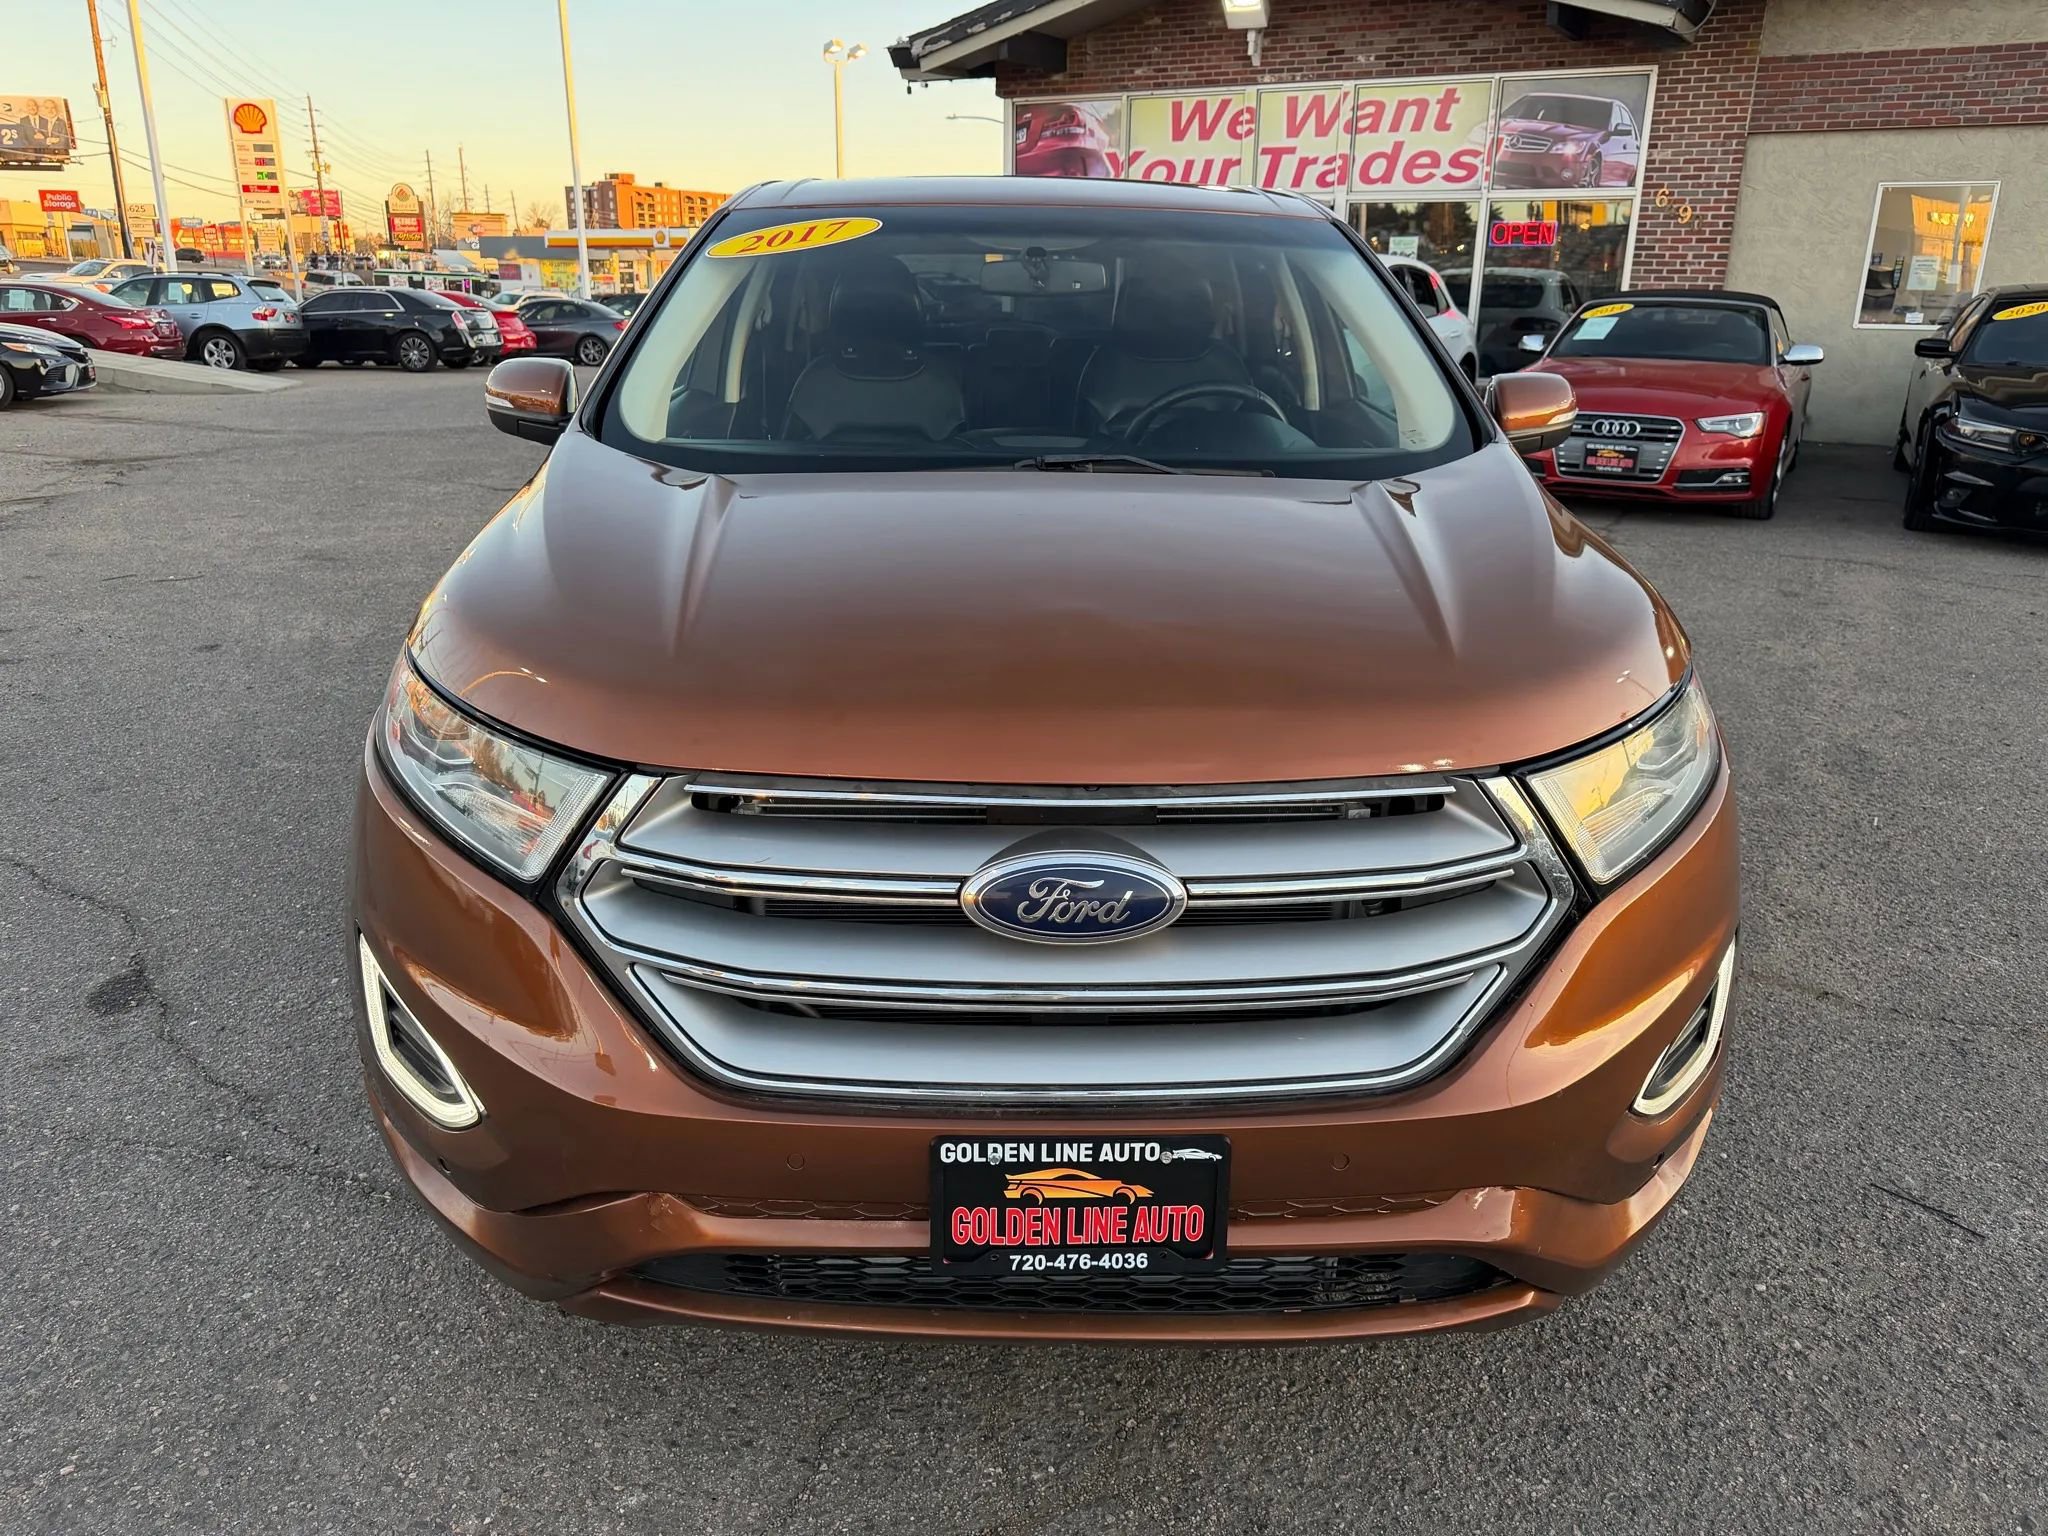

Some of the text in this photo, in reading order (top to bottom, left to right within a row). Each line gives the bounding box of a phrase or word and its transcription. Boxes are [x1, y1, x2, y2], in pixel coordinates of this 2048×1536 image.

[1171, 87, 1461, 141] We Want
[1104, 137, 1504, 189] Your Trades!
[44, 200, 76, 209] Storage
[46, 192, 72, 201] Public
[736, 221, 850, 254] 2017
[1491, 222, 1555, 245] OPEN
[2006, 303, 2046, 318] 2020
[1016, 876, 1134, 924] Ford
[940, 1142, 1160, 1164] GOLDEN LINE AUTO
[951, 1204, 1205, 1246] GOLDEN LINE AUTO
[1009, 1252, 1148, 1271] 720-476-4036
